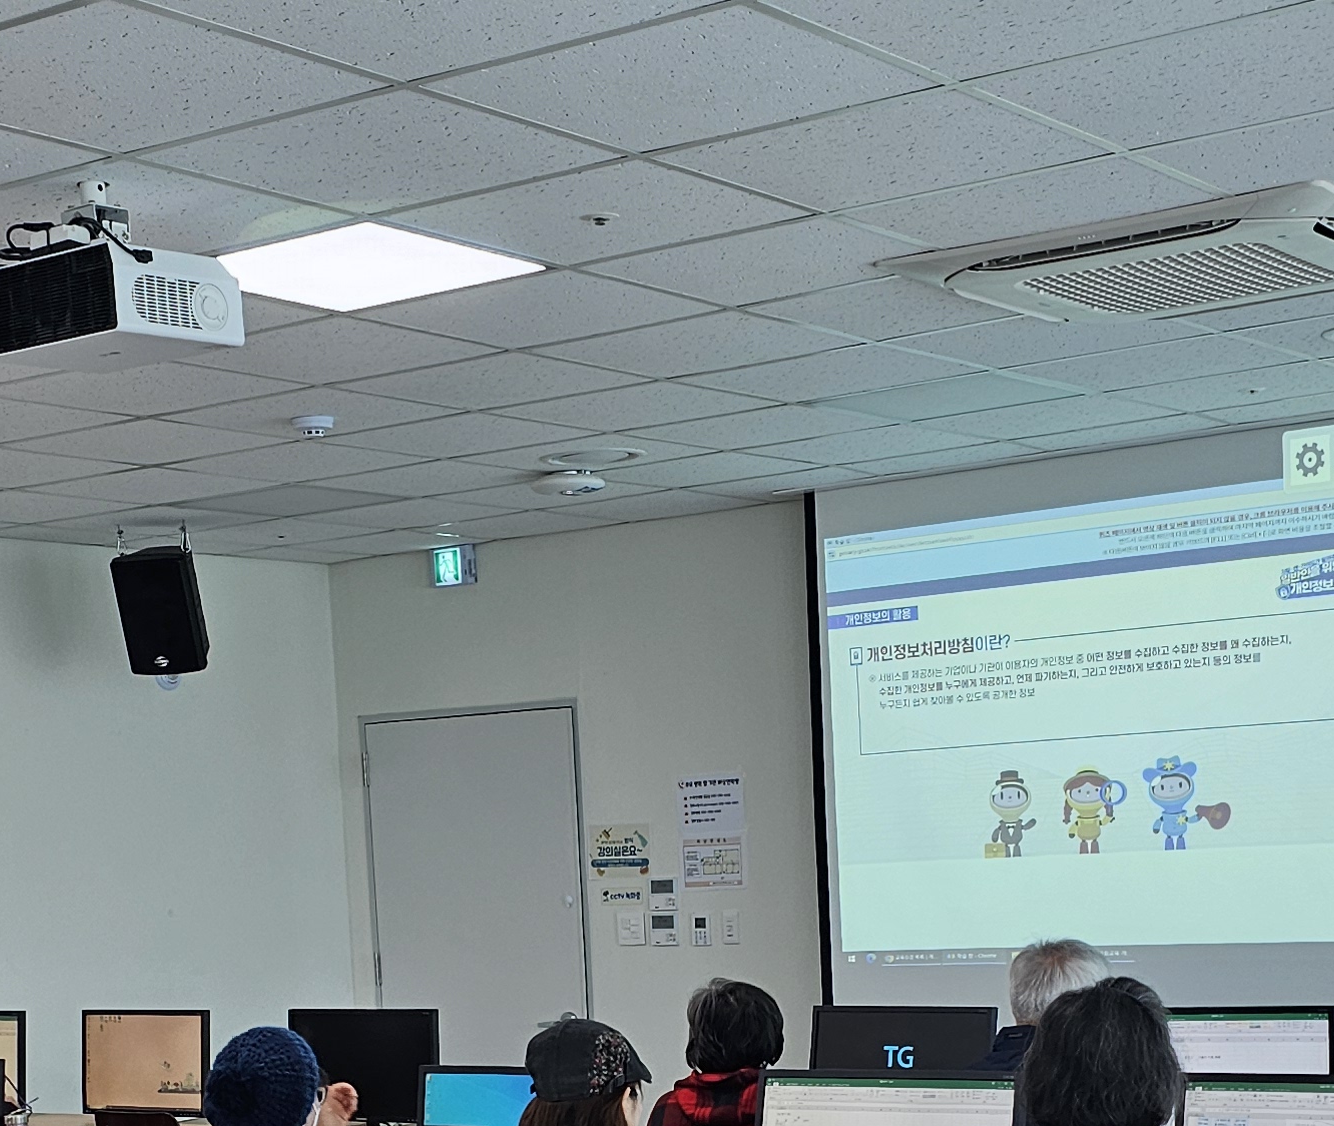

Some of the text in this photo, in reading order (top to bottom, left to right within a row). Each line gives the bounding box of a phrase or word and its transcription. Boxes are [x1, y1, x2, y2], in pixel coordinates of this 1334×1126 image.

[845, 607, 911, 626] 개인정보의 활용
[867, 634, 1011, 662] 개인정보처리방침이란?
[879, 670, 909, 682] 서비스를
[912, 668, 943, 679] 제공하는
[945, 664, 977, 676] 기업이나
[1005, 658, 1038, 671] 이용자의
[1040, 654, 1074, 668] 개인정보
[1087, 652, 1104, 663] 어떤
[1106, 649, 1132, 661] 정보를
[1135, 646, 1169, 658] 수집하고
[1172, 644, 1198, 655] 수집한
[1201, 640, 1228, 652] 정보를
[879, 684, 902, 696] 수집한
[904, 681, 943, 694] 개인정보를
[945, 678, 977, 690] 누구에게
[1017, 673, 1033, 684] 언제
[1082, 667, 1107, 678] 그리고
[1109, 664, 1143, 676] 안전하게
[1147, 659, 1181, 672] 보호하고
[1184, 657, 1210, 668] 있는지
[1233, 652, 1261, 664] 정보를
[879, 698, 911, 710] 누구든지
[1019, 688, 1035, 698] 정보
[883, 1045, 914, 1069] TG
